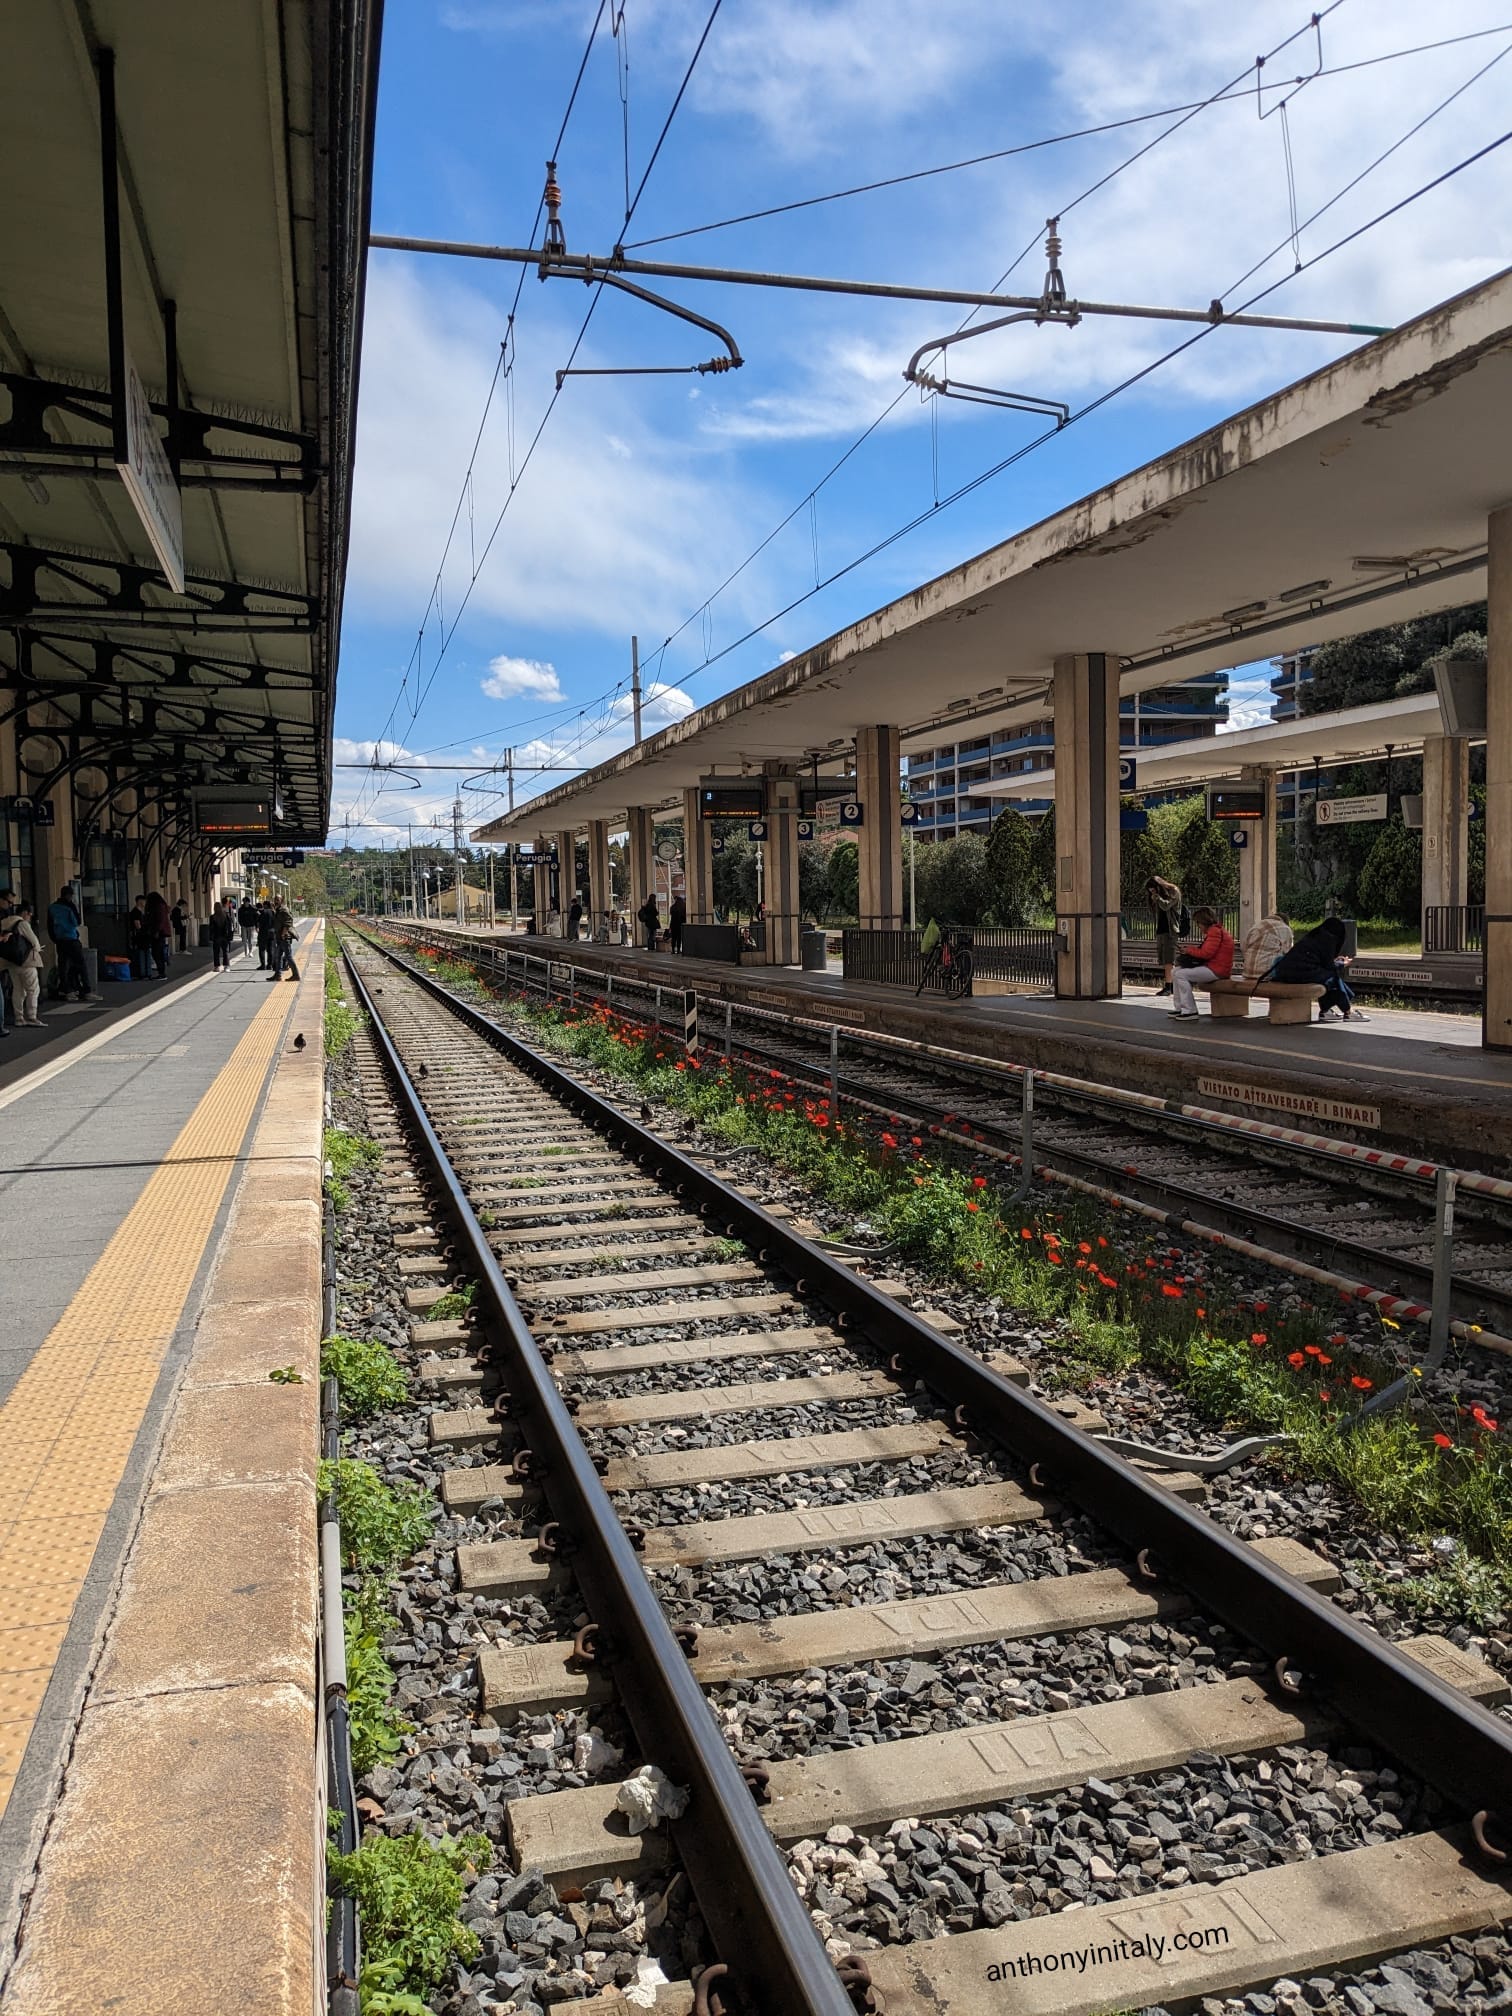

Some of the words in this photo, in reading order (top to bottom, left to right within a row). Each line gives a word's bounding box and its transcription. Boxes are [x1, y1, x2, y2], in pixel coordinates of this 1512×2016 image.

[847, 806, 855, 816] 2
[243, 853, 284, 864] Perugia
[516, 853, 552, 864] Perugia
[1203, 1080, 1240, 1098] VIETATO
[1244, 1088, 1319, 1113] ATTRAVERSARE
[1323, 1103, 1328, 1115] I
[1332, 1106, 1374, 1124] BINARI
